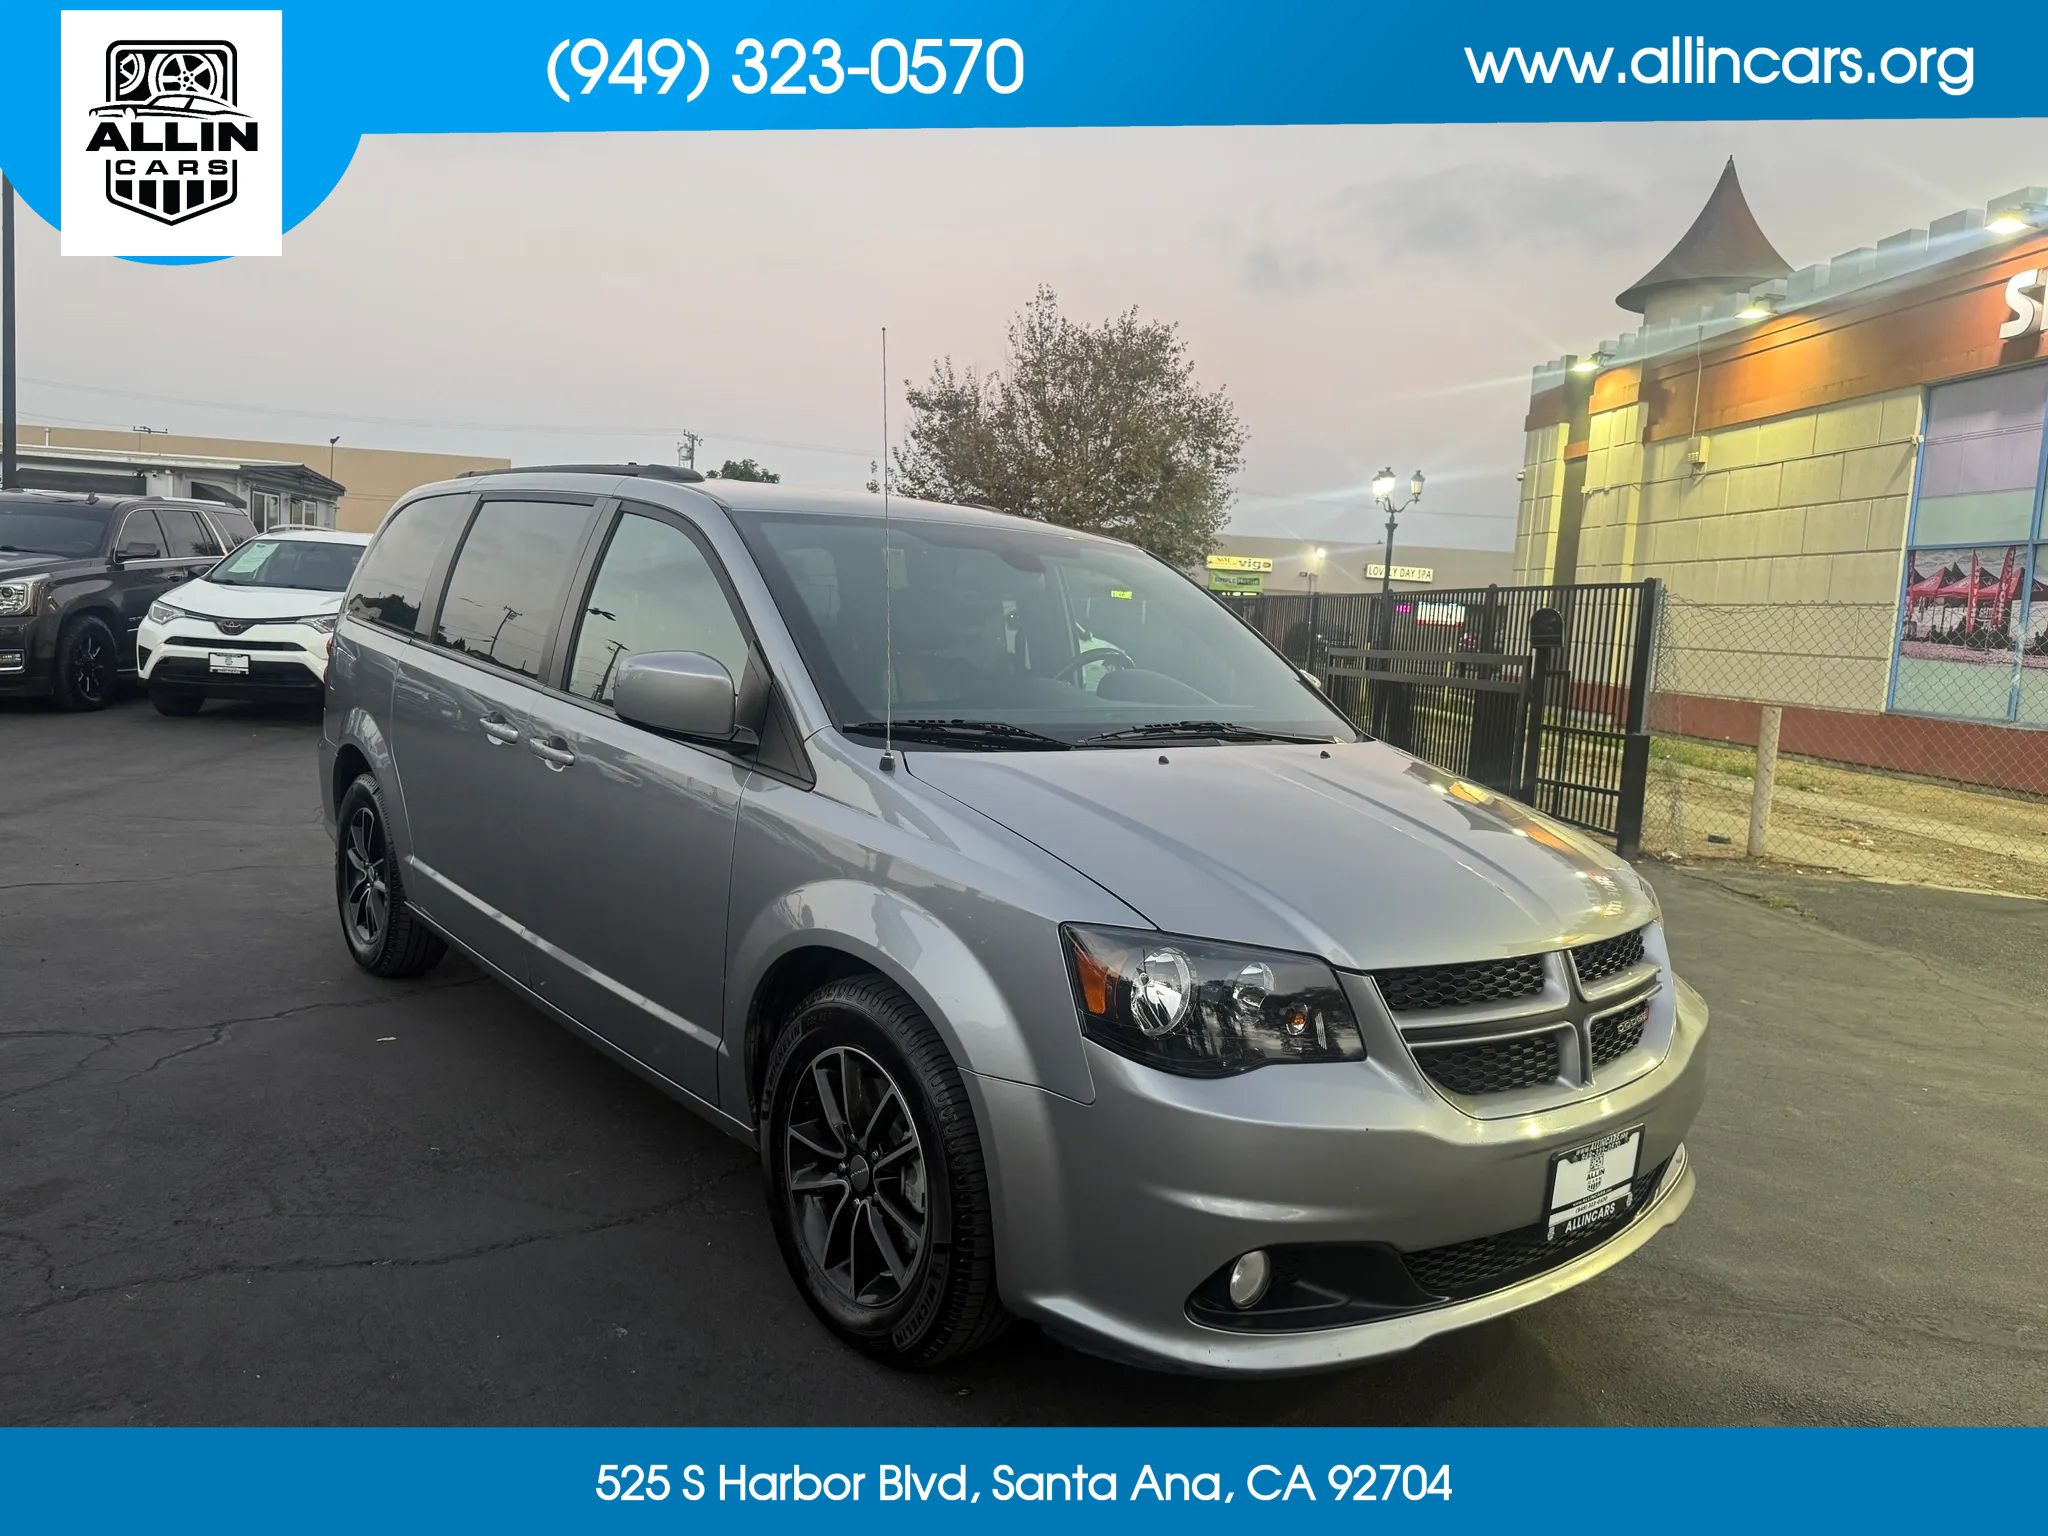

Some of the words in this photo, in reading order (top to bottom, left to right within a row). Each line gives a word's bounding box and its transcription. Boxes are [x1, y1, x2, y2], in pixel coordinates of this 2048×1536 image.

[1999, 267, 2048, 339] S
[1368, 566, 1398, 577] LOVY
[1399, 568, 1416, 578] DAY
[1417, 568, 1432, 580] SPA
[1585, 1167, 1605, 1181] ALLIN
[1564, 1201, 1616, 1234] ALLINCARS
